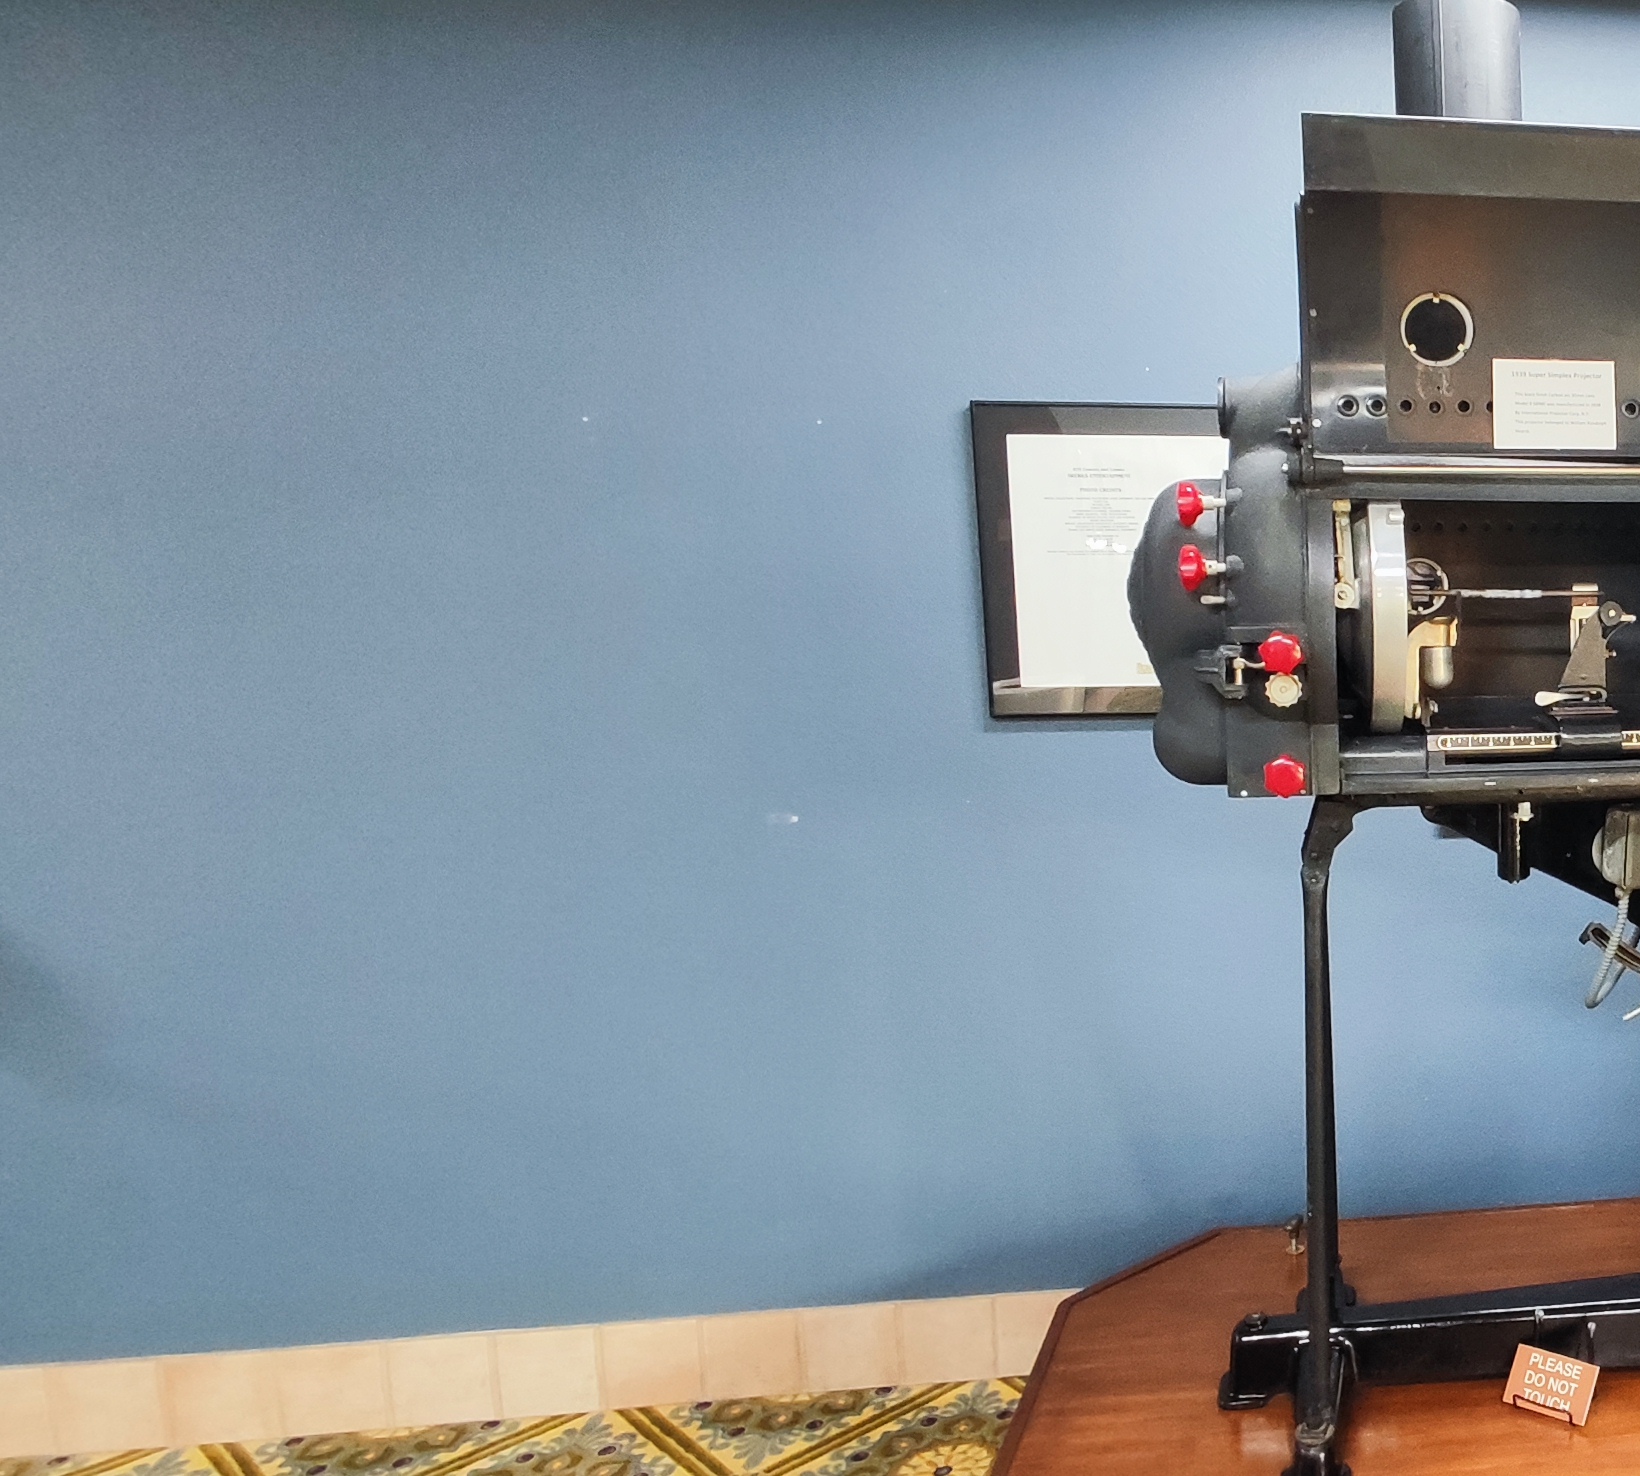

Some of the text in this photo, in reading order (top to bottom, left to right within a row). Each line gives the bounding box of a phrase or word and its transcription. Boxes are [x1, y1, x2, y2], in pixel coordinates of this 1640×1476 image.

[1573, 372, 1602, 381] Projector
[1529, 1352, 1583, 1380] PLEASE
[1523, 1370, 1579, 1397] DO NOT
